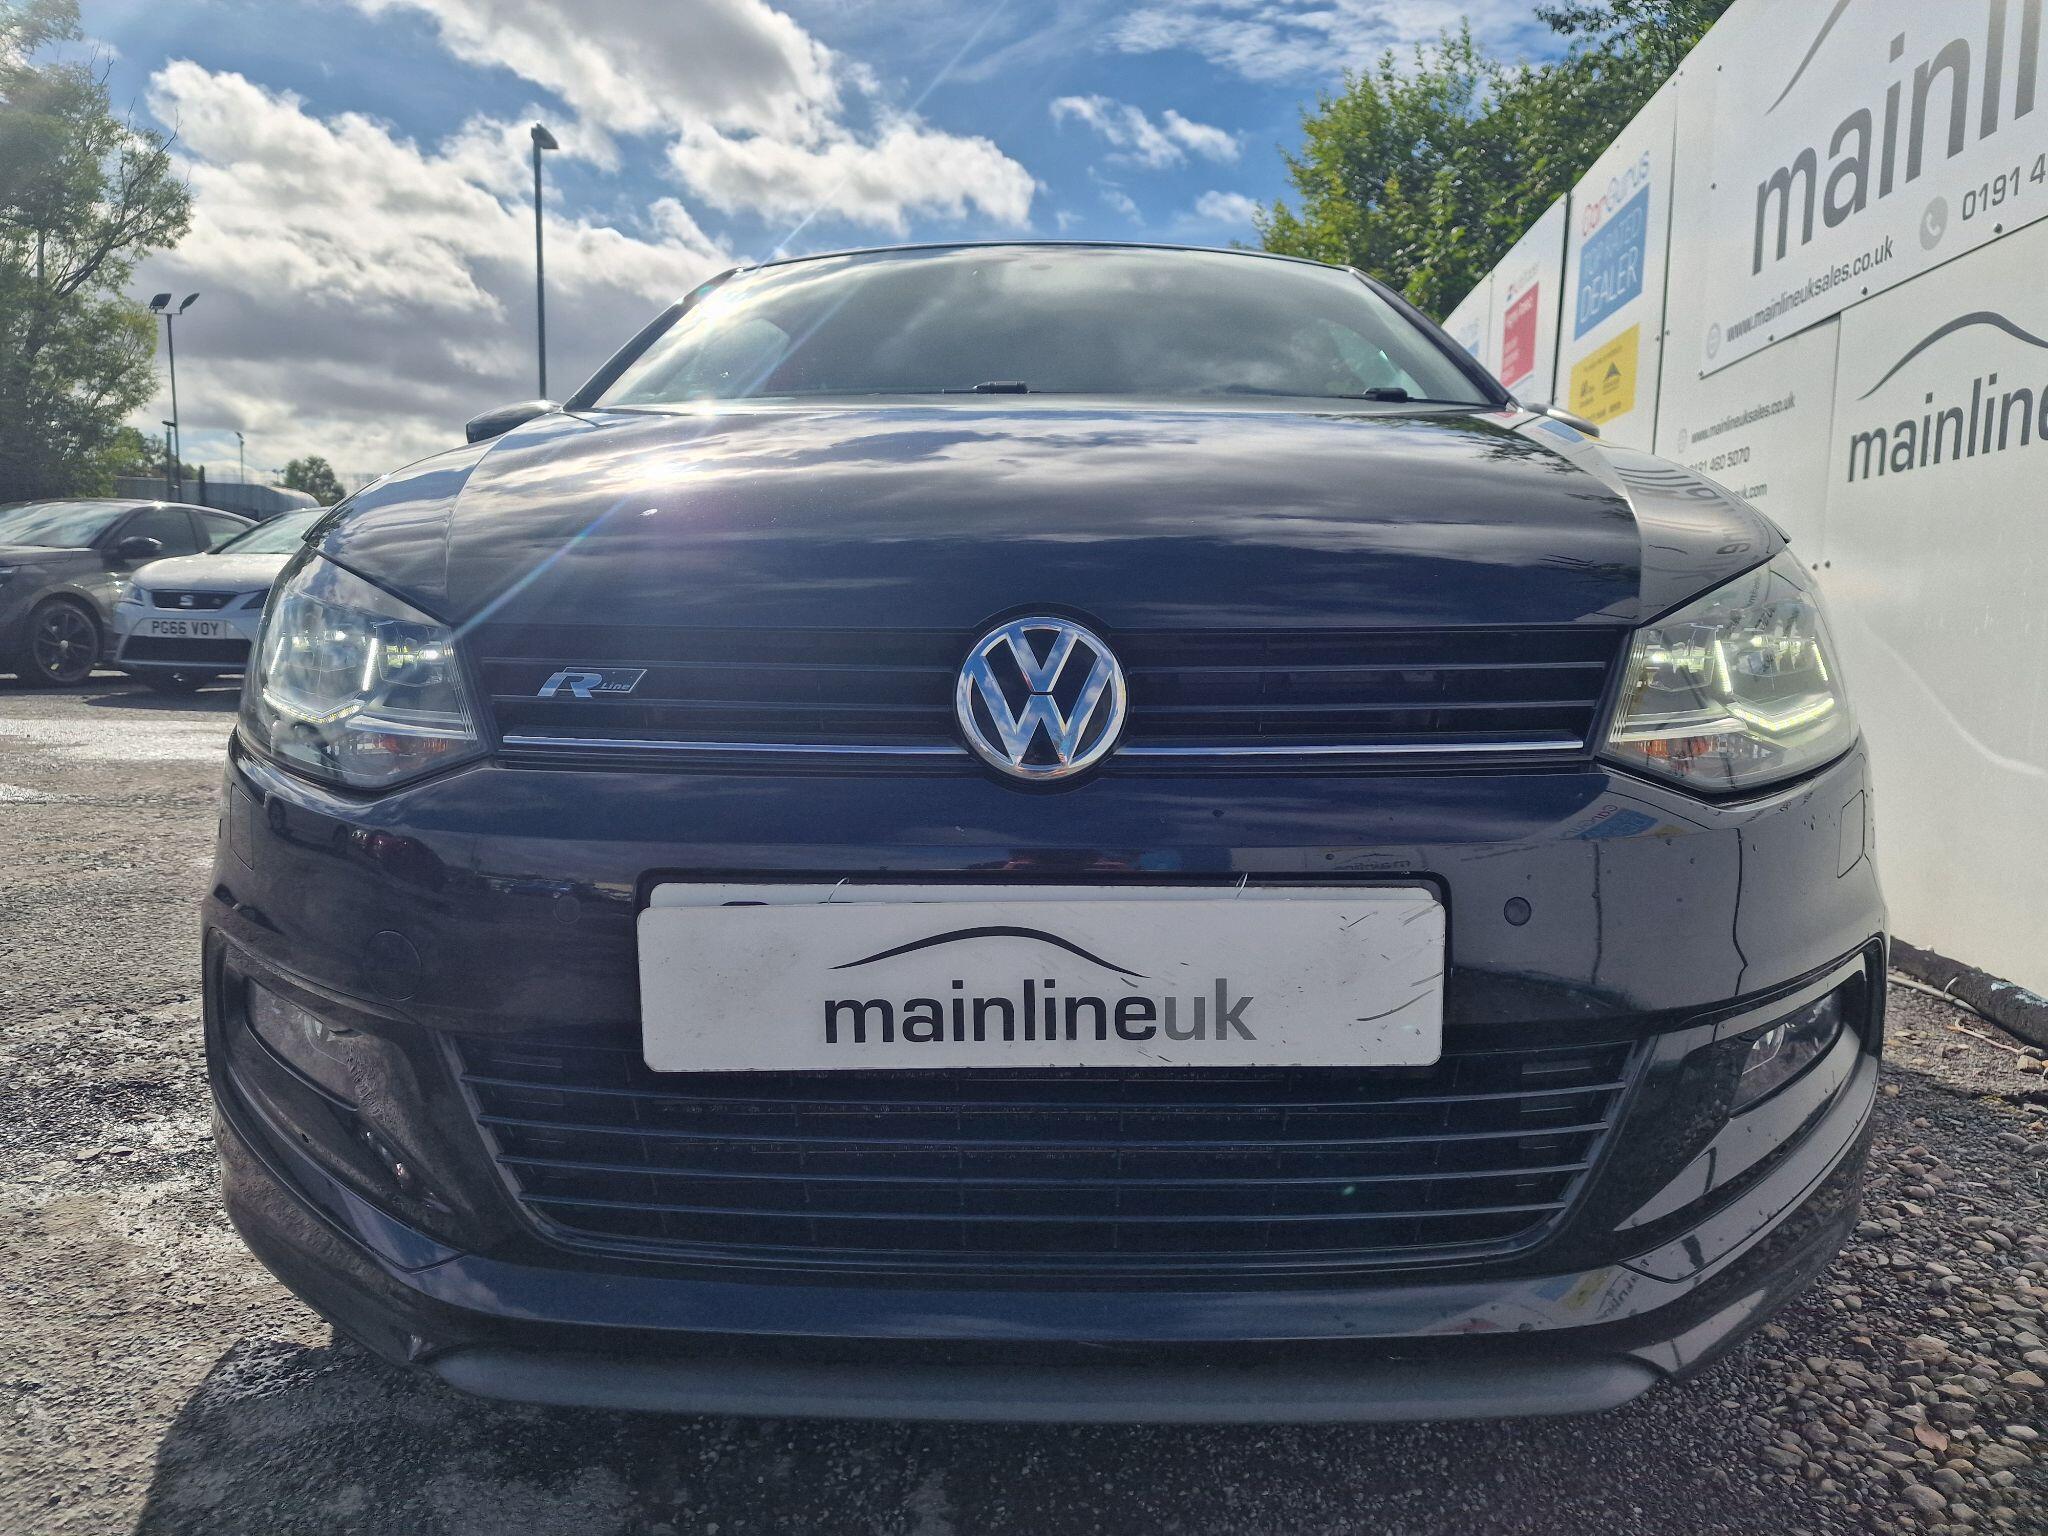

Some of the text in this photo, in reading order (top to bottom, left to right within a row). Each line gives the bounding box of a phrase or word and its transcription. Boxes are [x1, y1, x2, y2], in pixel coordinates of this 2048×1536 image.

[1962, 166, 2020, 221] 0191
[1581, 246, 1639, 322] DEALER
[1727, 235, 1893, 342] www.mainlineuksales.co.uk
[1691, 391, 1796, 443] www.mainlineuksales.co.uk
[1709, 454, 1726, 471] 460
[1727, 446, 1750, 467] 5070
[152, 621, 218, 635] PG66 VOY
[824, 978, 1258, 1044] mainlineuk
